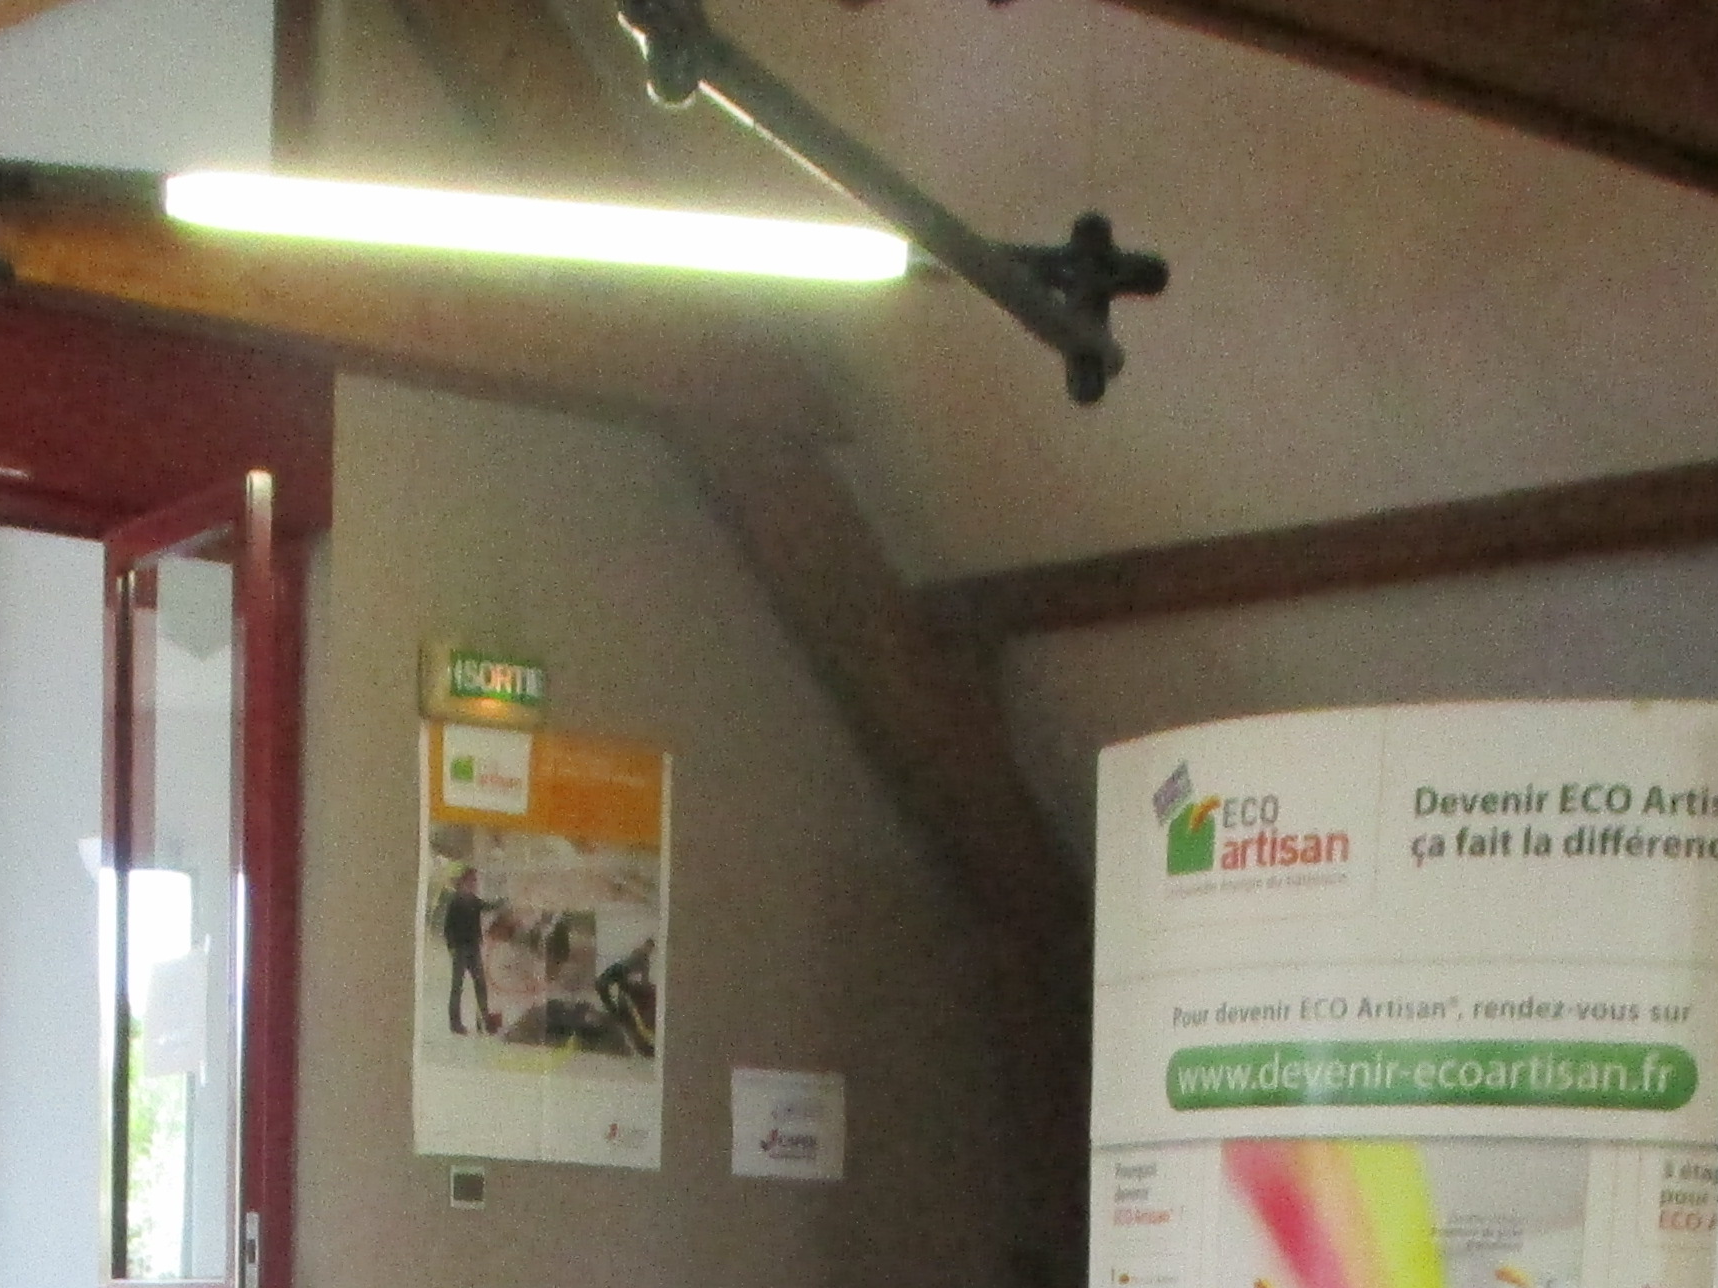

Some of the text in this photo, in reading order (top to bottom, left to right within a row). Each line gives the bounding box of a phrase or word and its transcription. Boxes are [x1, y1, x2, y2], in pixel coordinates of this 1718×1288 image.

[1222, 795, 1279, 829] ECO
[1414, 784, 1549, 818] Devenir
[1559, 784, 1632, 815] ECO
[1220, 827, 1350, 871] artisan
[1410, 833, 1446, 867] ça
[1455, 825, 1512, 857] fait
[1523, 825, 1553, 857] la
[1172, 1003, 1209, 1028] Pour
[1215, 1000, 1289, 1025] devenir
[1299, 998, 1349, 1021] ECO
[1472, 997, 1640, 1022] rendez-vous
[1648, 1001, 1691, 1023] sur
[1177, 1049, 1675, 1096] www.devenir-ecoartisan.fr
